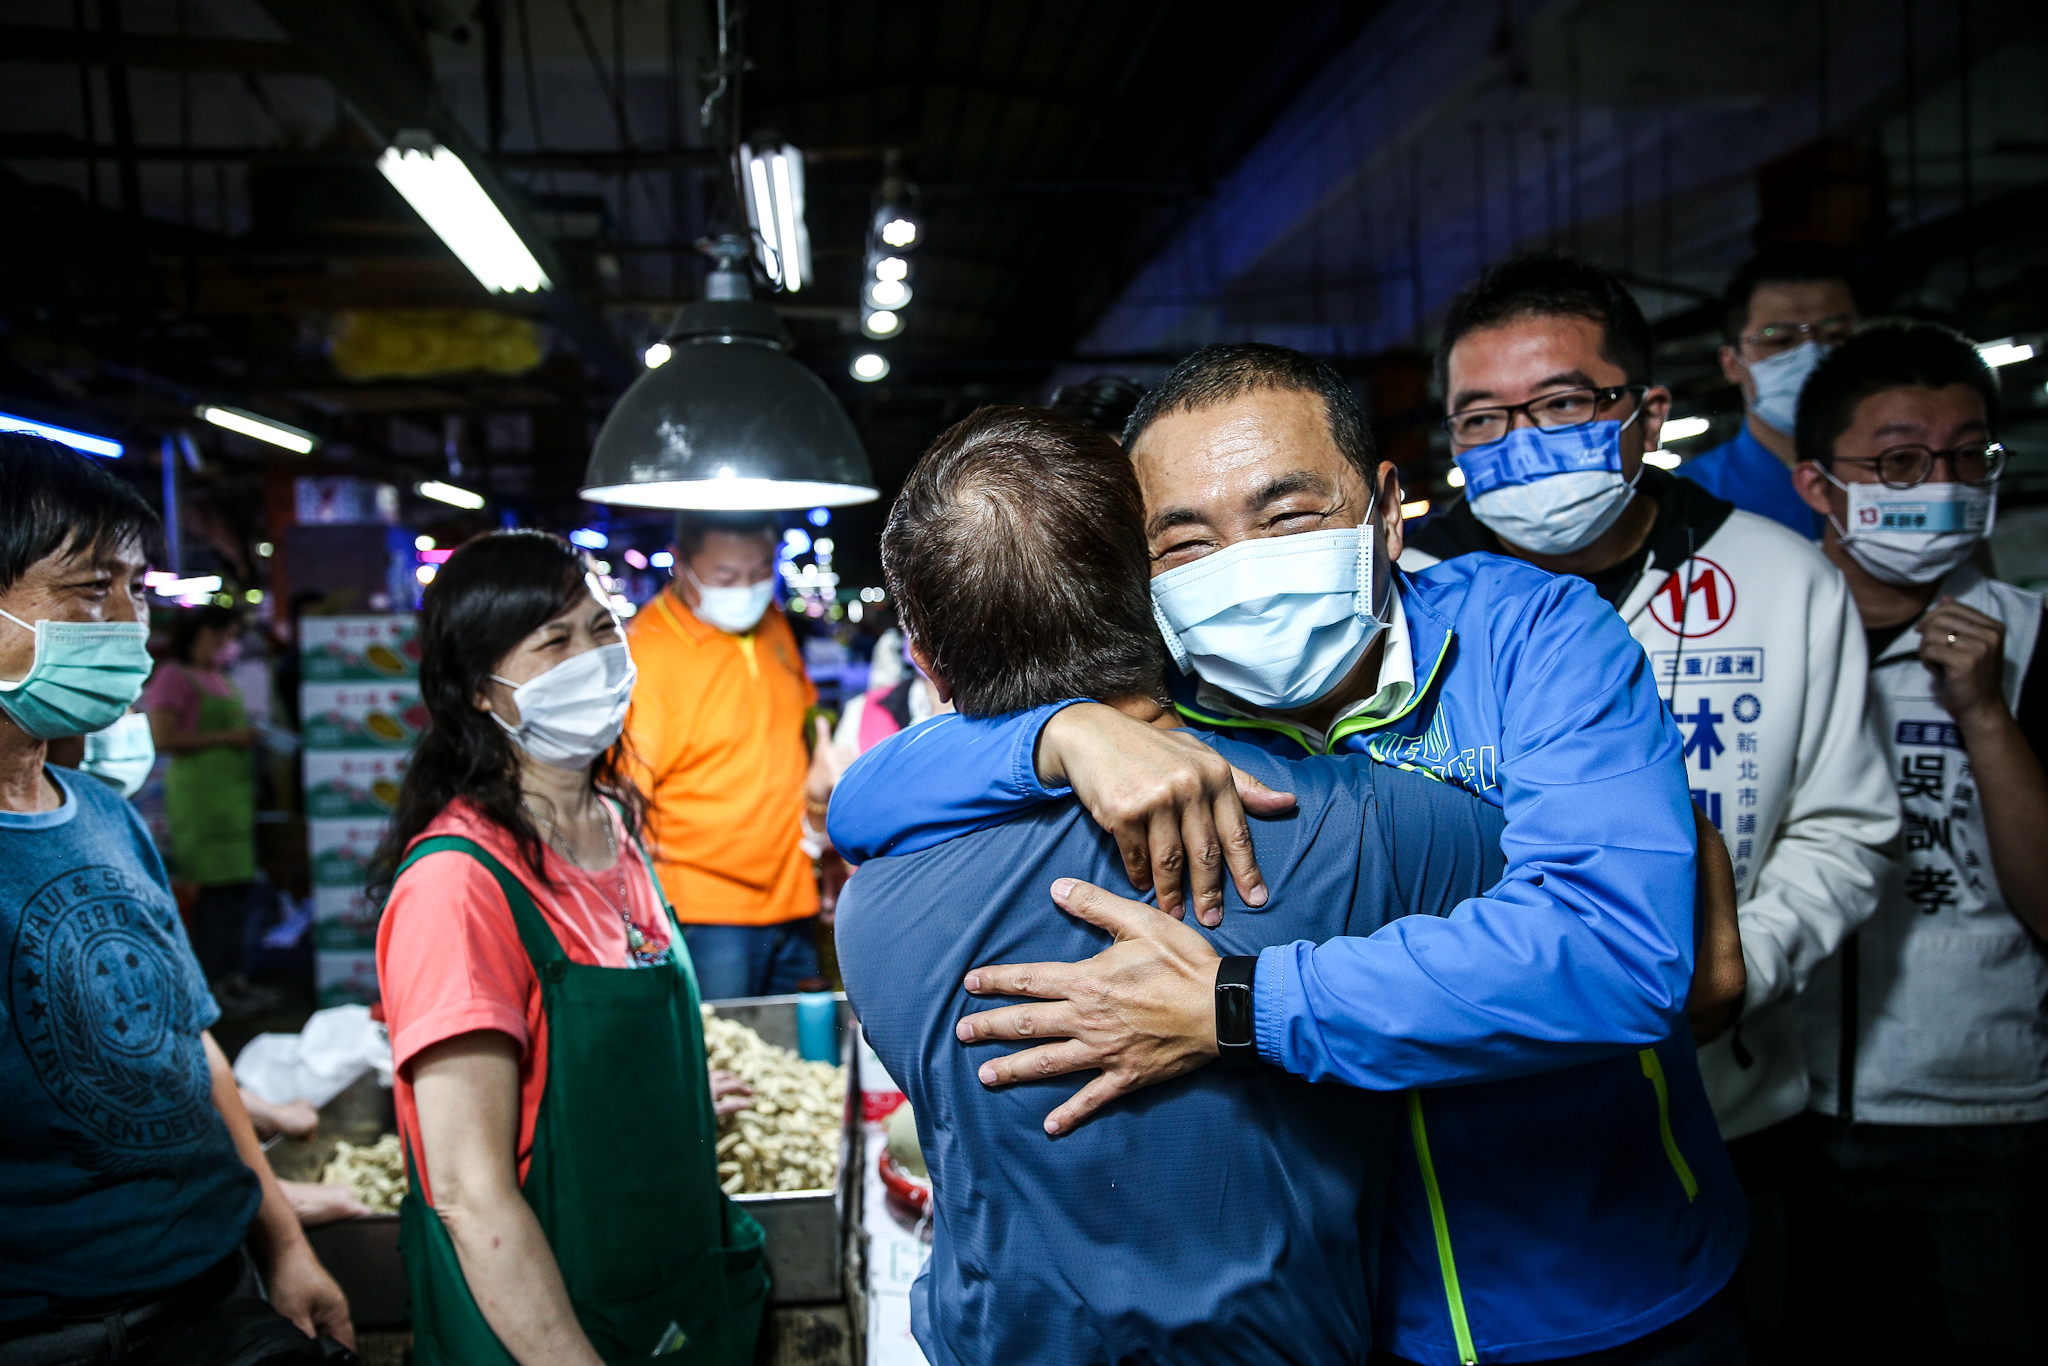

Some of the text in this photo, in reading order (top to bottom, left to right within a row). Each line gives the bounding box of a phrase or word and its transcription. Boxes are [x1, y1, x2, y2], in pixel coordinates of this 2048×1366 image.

[1858, 507, 1879, 525] 13
[1656, 568, 1721, 624] 11
[1898, 754, 1957, 915] 吳訓孝
[21, 889, 67, 962] MAUI
